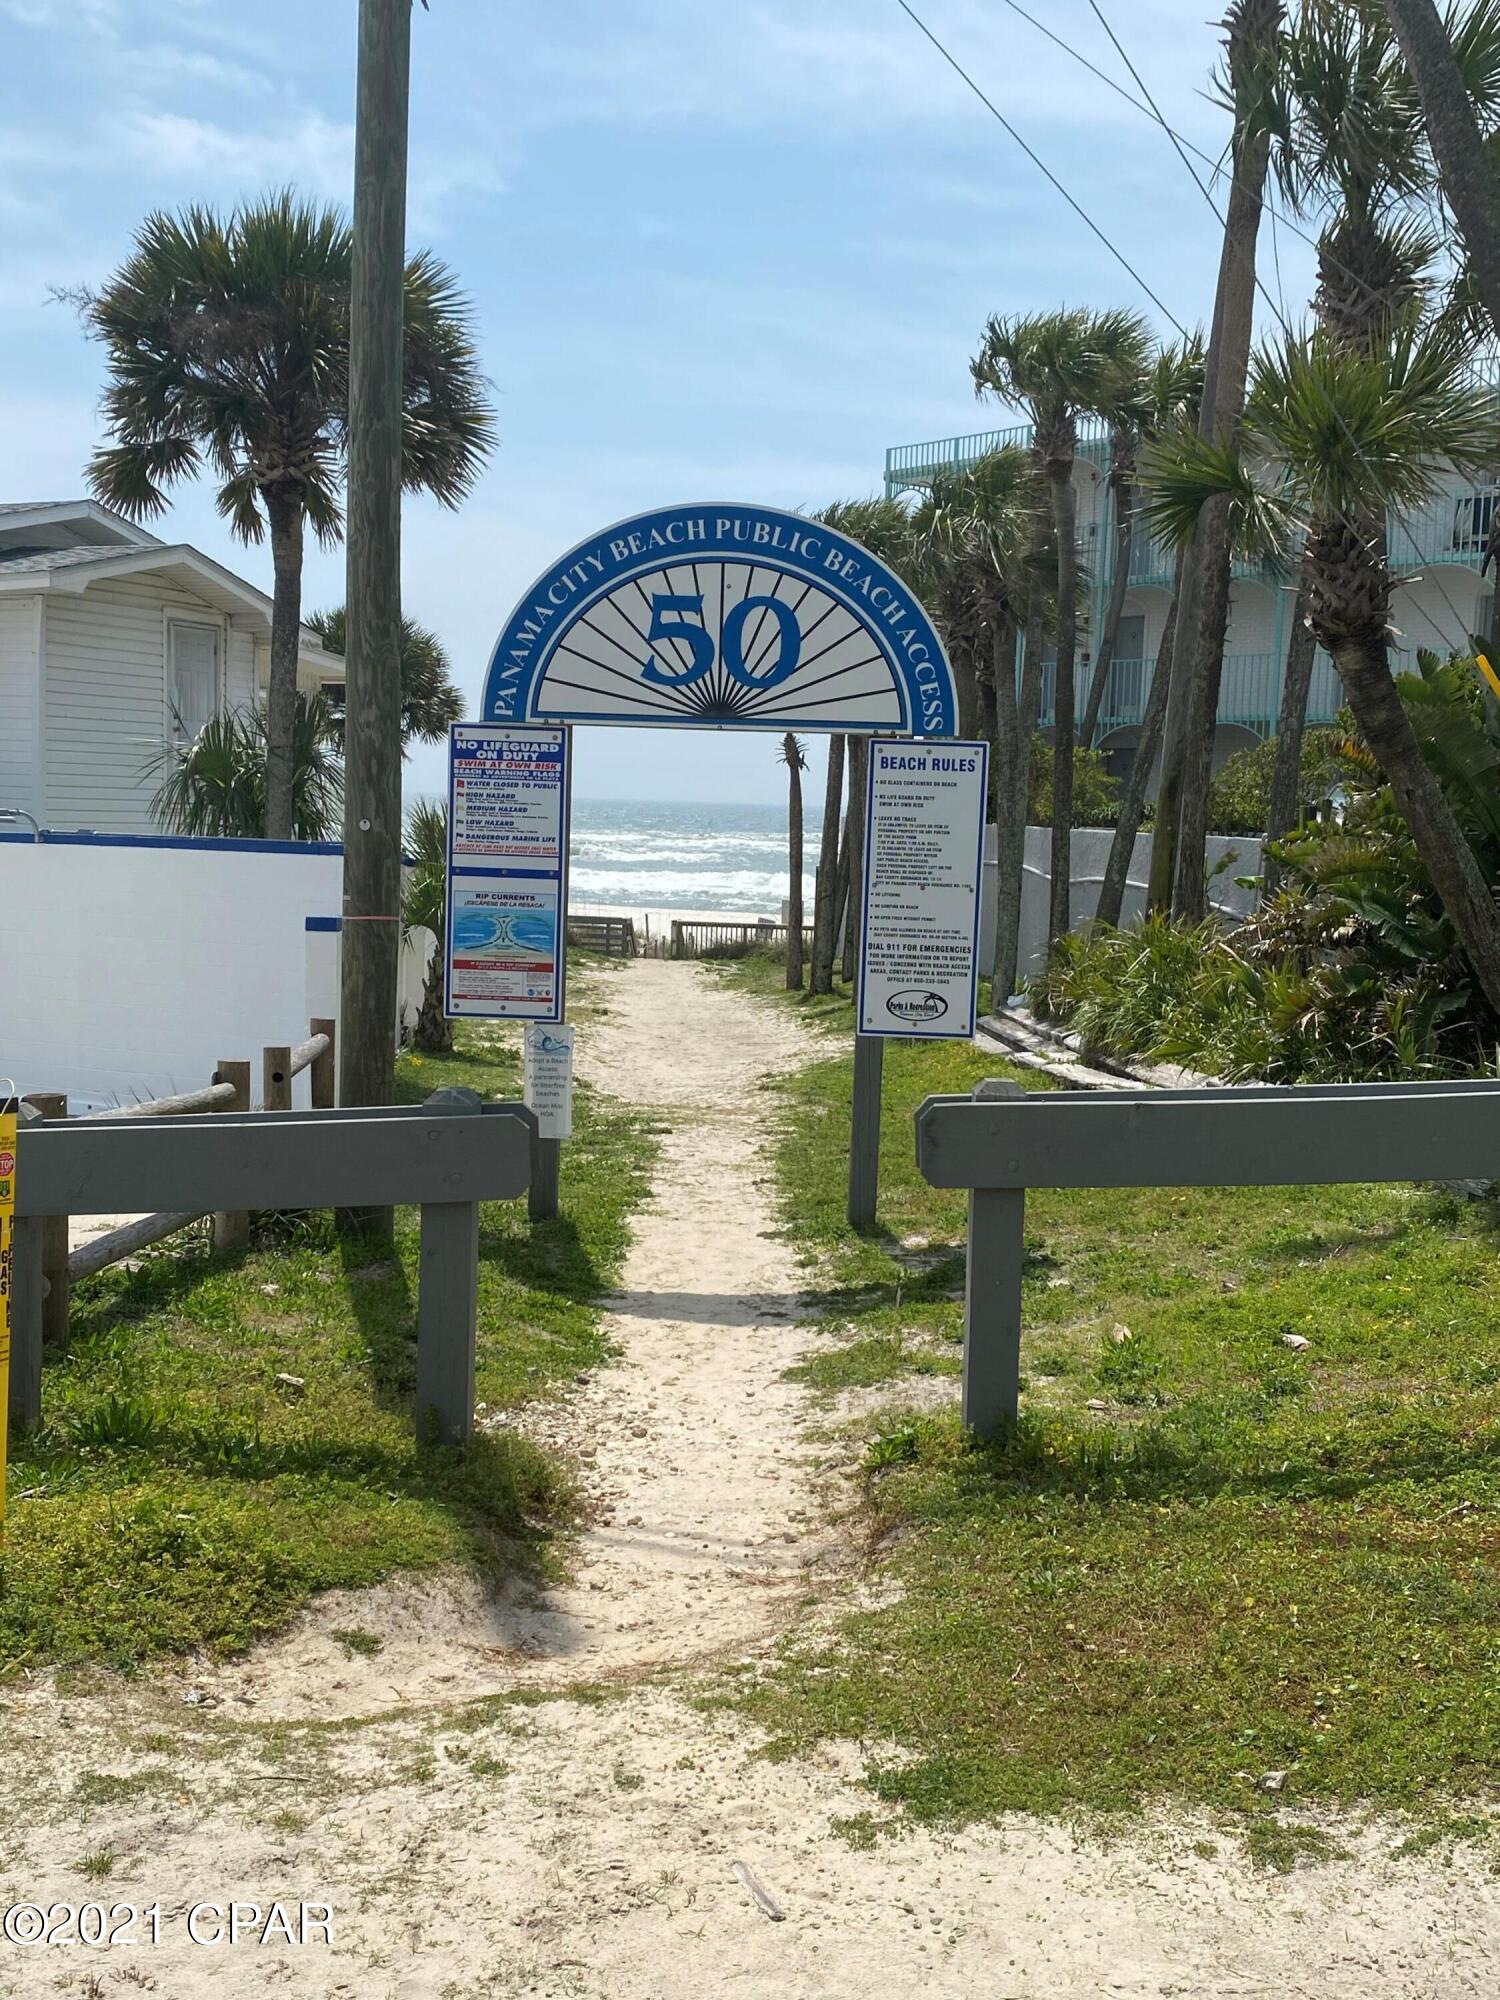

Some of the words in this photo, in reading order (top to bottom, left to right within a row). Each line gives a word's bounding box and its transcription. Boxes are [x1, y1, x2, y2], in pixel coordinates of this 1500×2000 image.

[494, 604, 554, 716] PANAMA
[548, 550, 604, 605] CITY
[609, 519, 705, 561] BEACH
[715, 519, 822, 559] PUBLIC
[823, 548, 908, 626] BEACH
[896, 629, 943, 731] ACCESS
[640, 591, 801, 688] 50
[456, 740, 478, 750] NO
[483, 742, 560, 752] LIFEGUARD
[476, 750, 497, 759] ON
[503, 752, 540, 760] DUTY
[457, 760, 486, 768] SWIM
[534, 762, 558, 770] RISK
[880, 756, 926, 771] BEACH
[932, 758, 975, 772] RULES
[902, 944, 917, 952] FOR
[920, 944, 972, 954] EMERGENCIES
[890, 1002, 904, 1010] Parks
